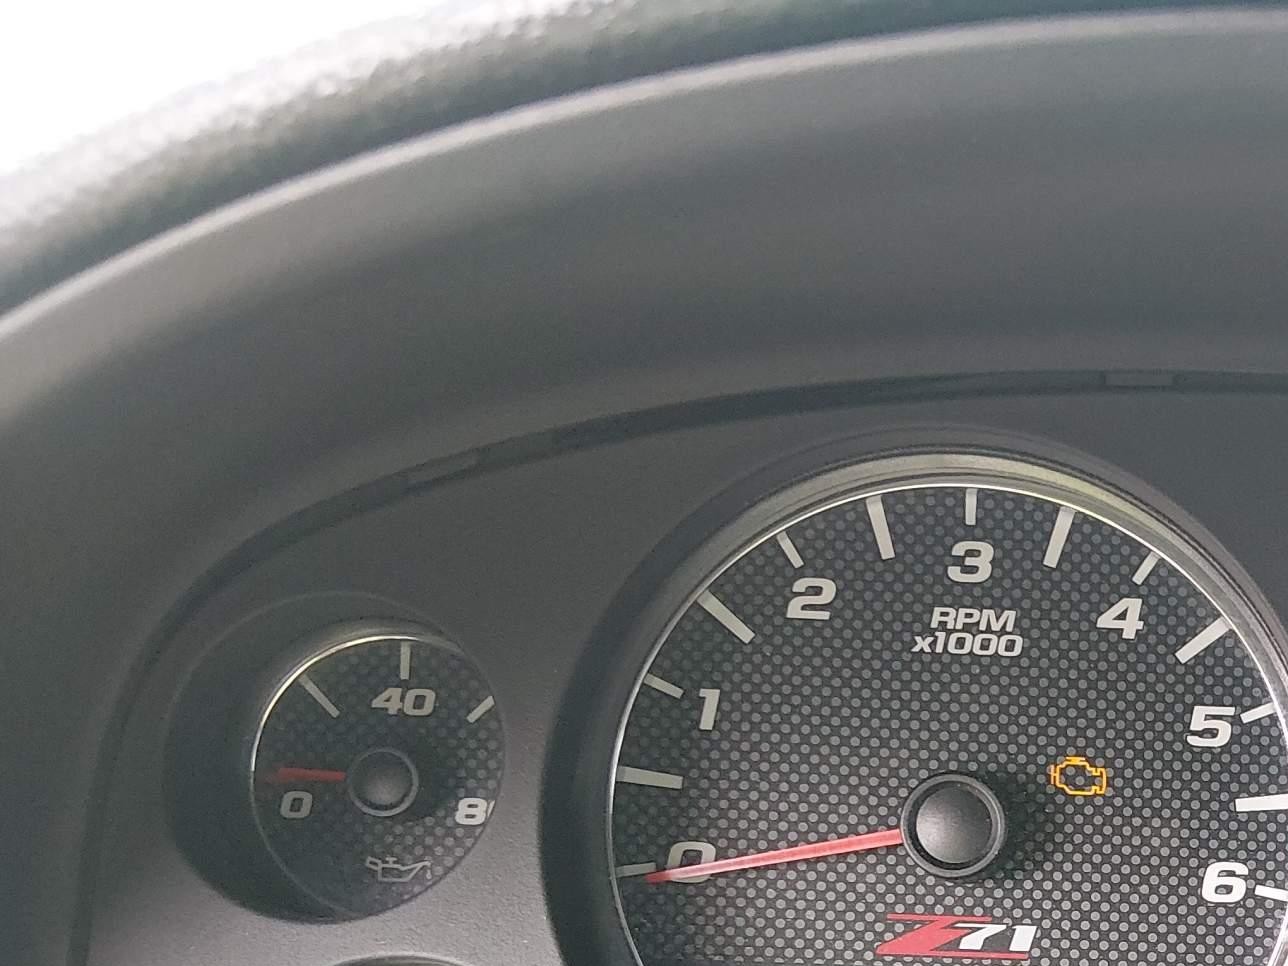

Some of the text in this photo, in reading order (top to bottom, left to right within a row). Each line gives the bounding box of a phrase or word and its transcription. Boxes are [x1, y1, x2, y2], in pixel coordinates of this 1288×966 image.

[947, 541, 994, 583] 3
[786, 577, 837, 620] 2
[930, 607, 1017, 632] RPM
[1096, 598, 1144, 640] 4
[910, 631, 1023, 657] x1000
[371, 688, 436, 716] 40
[699, 688, 720, 730] 1
[1186, 706, 1236, 747] 5
[279, 791, 313, 819] 0
[455, 797, 487, 826] 8
[666, 841, 717, 883] 0
[1201, 861, 1250, 903] 6
[875, 913, 1037, 960] Z71
